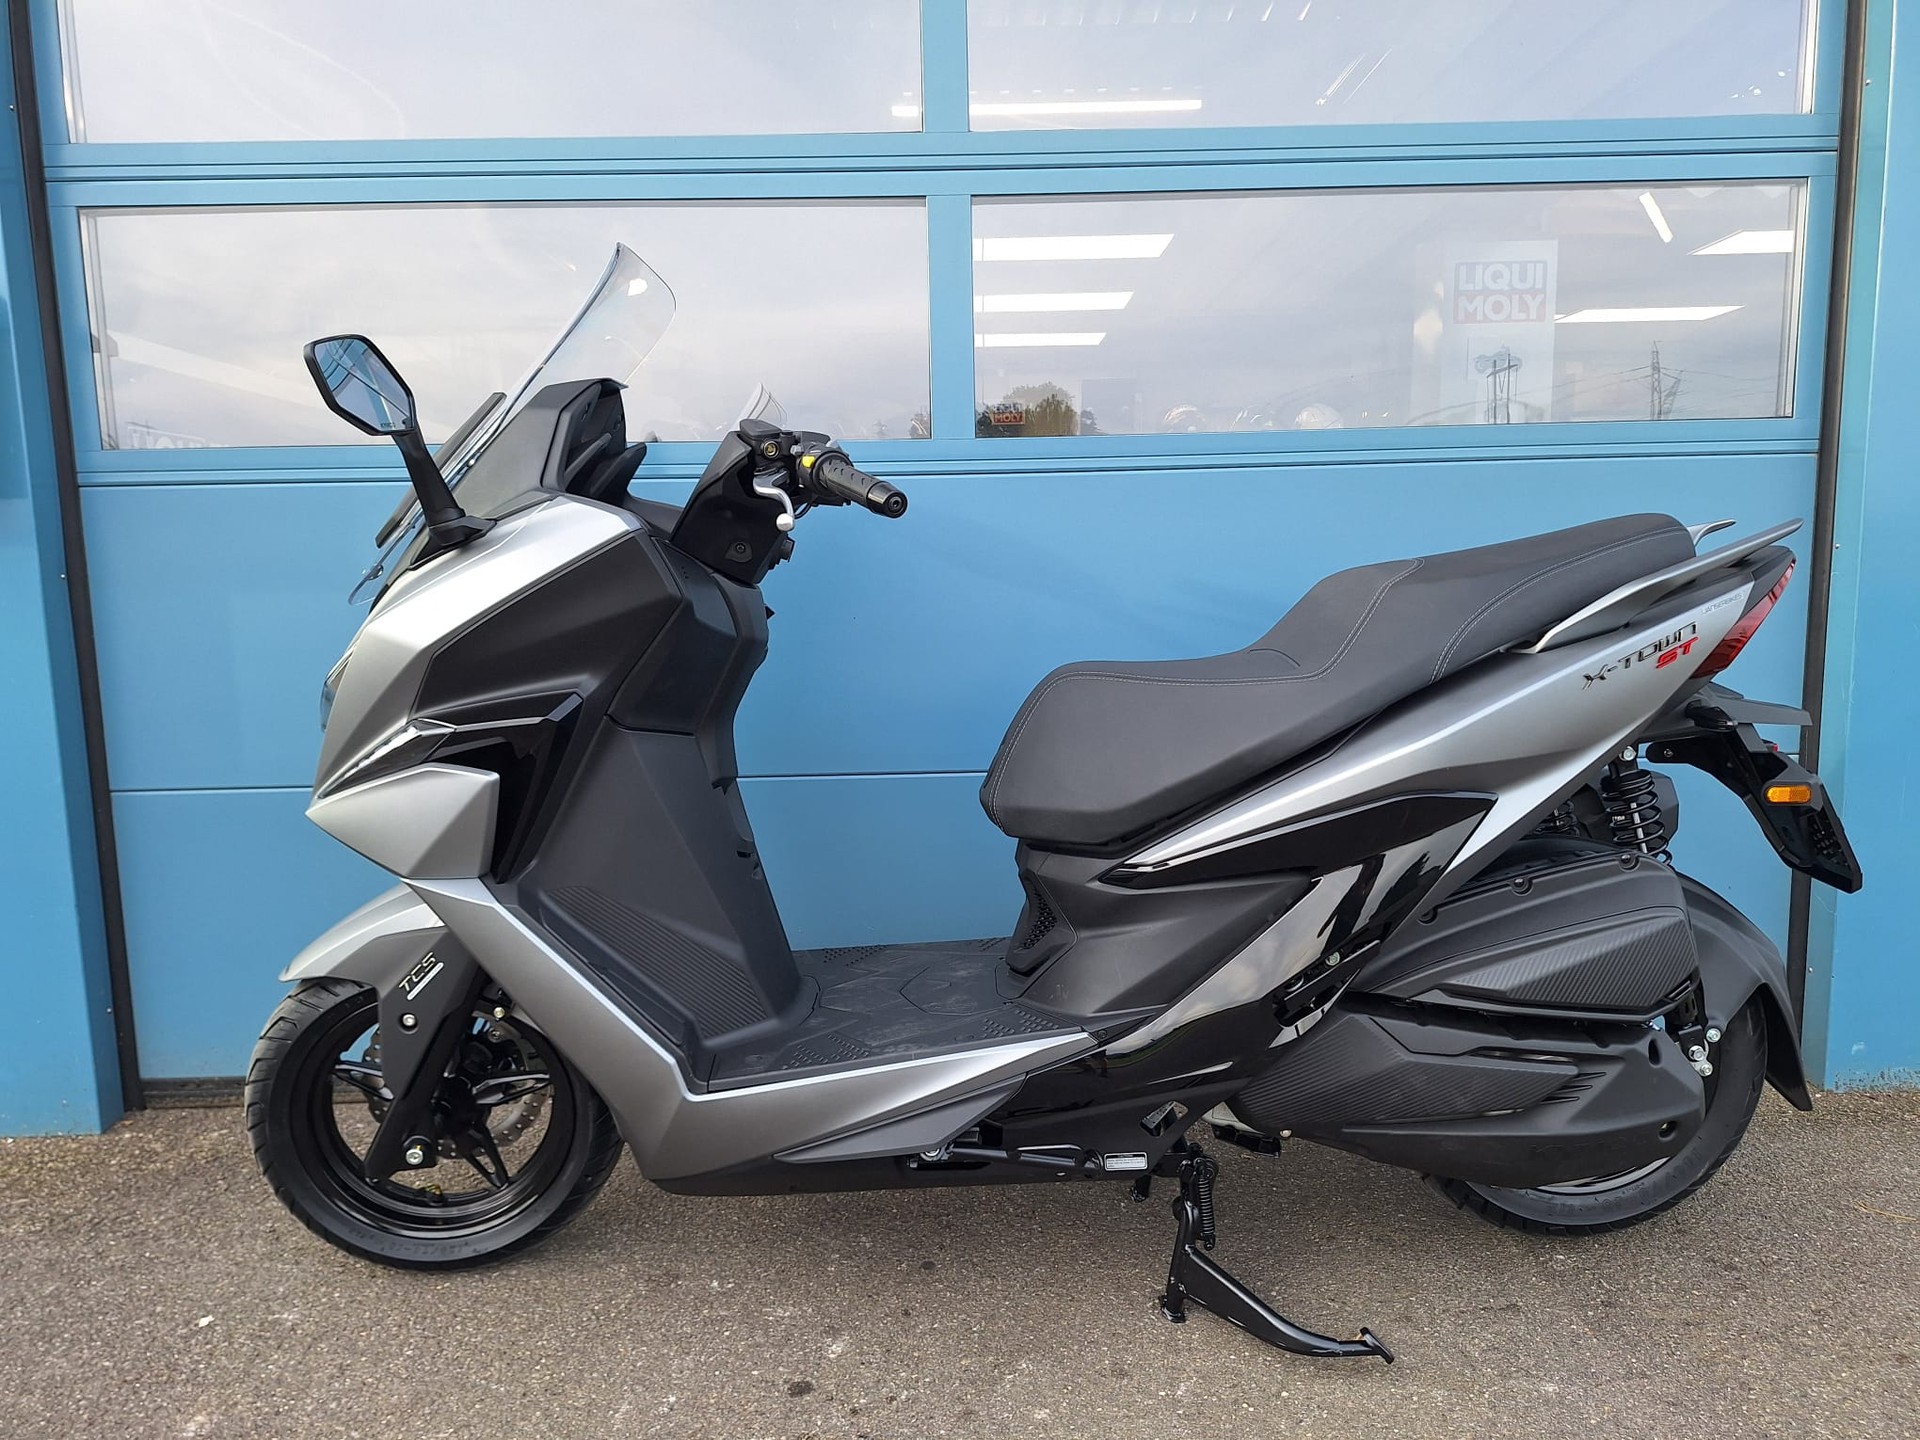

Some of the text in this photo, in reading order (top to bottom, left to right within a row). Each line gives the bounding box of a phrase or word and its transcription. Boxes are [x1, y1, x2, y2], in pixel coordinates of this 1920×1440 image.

[1459, 262, 1544, 291] LIQUI
[1458, 293, 1545, 322] MOLY
[994, 413, 1021, 423] MOLY
[1655, 636, 1699, 669] ST
[398, 951, 436, 992] TCS
